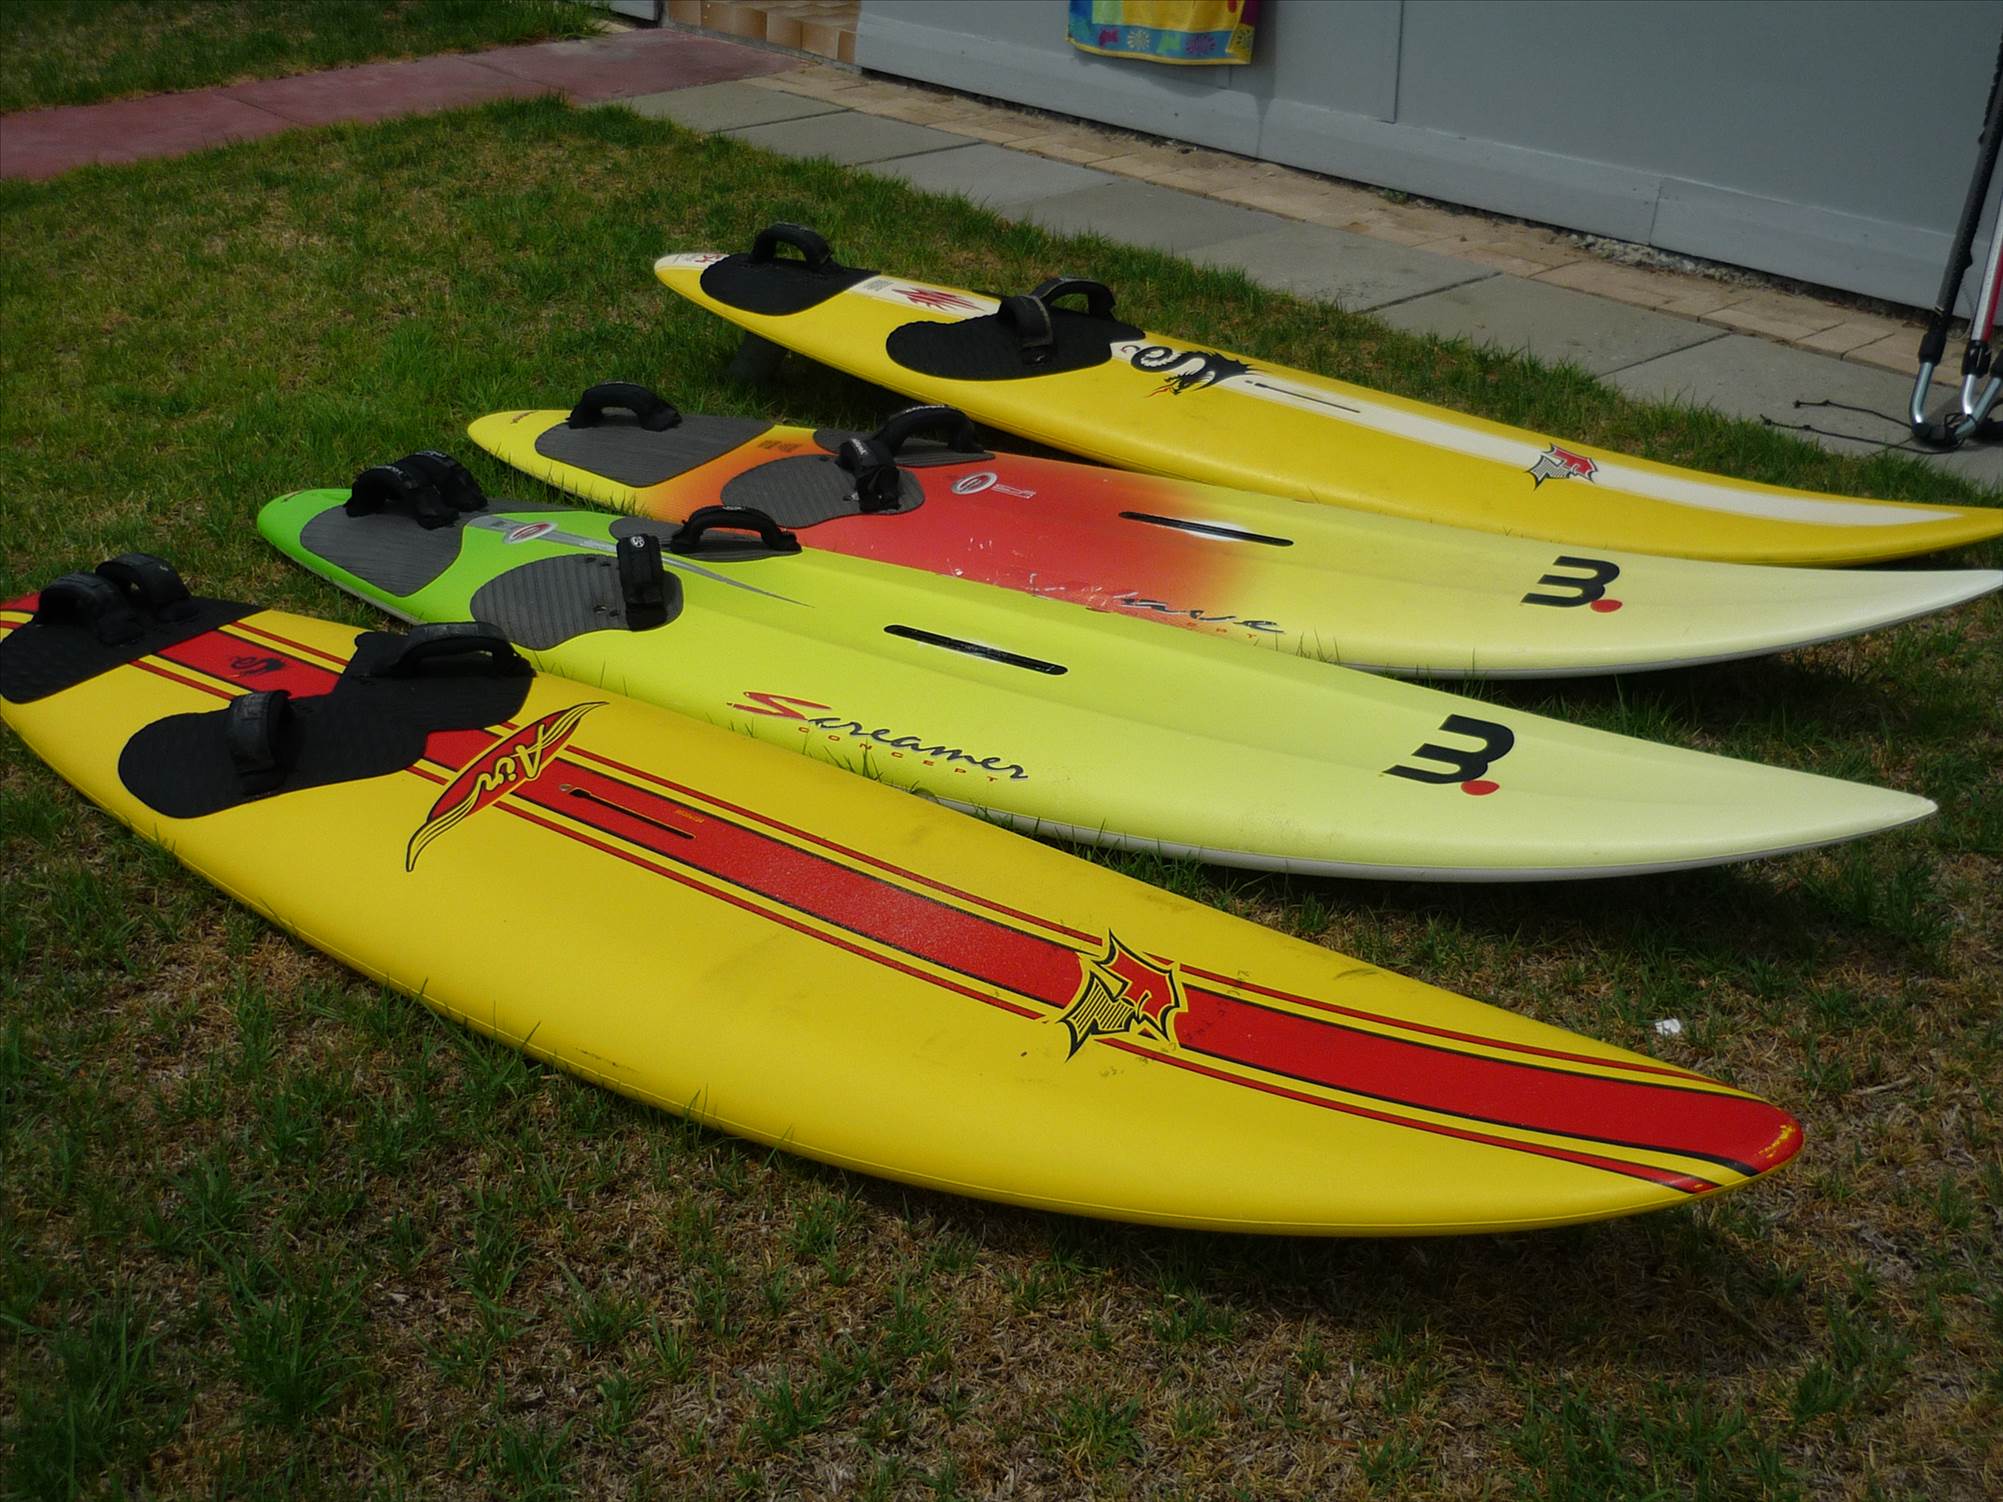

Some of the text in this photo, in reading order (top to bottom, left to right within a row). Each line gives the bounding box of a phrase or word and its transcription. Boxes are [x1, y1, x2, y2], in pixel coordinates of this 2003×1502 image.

[476, 722, 546, 792] Air
[726, 691, 1029, 780] Screamer
[798, 724, 998, 783] CONCEPT
